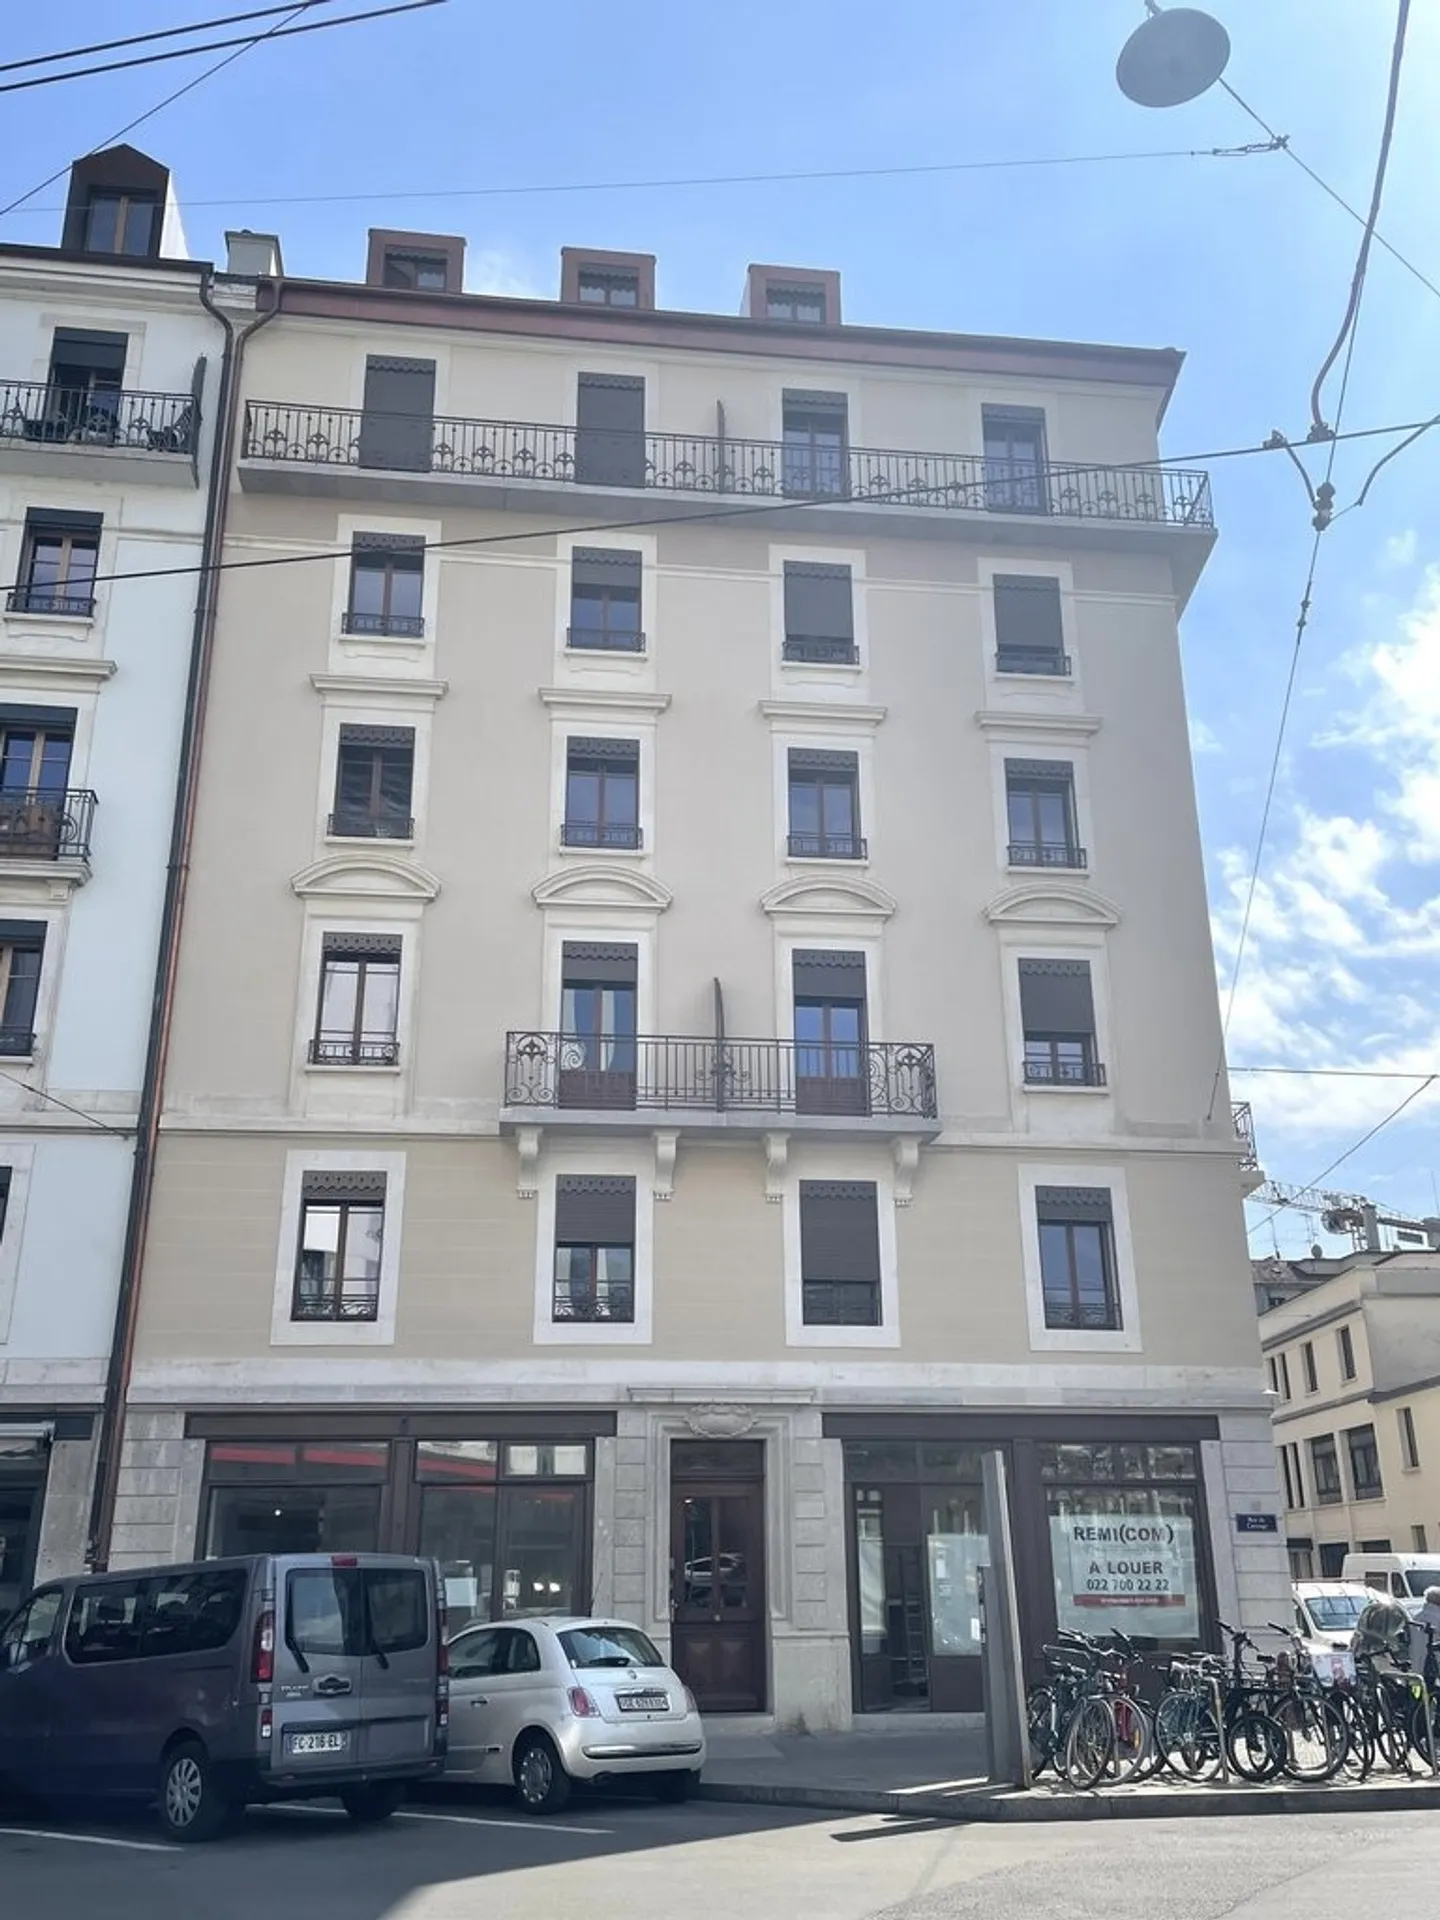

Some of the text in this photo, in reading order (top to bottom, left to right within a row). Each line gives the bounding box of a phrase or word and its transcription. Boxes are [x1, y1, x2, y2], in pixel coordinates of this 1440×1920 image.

[1089, 1562, 1163, 1574] A LOUER
[1087, 1579, 1169, 1591] 022 700 22 22
